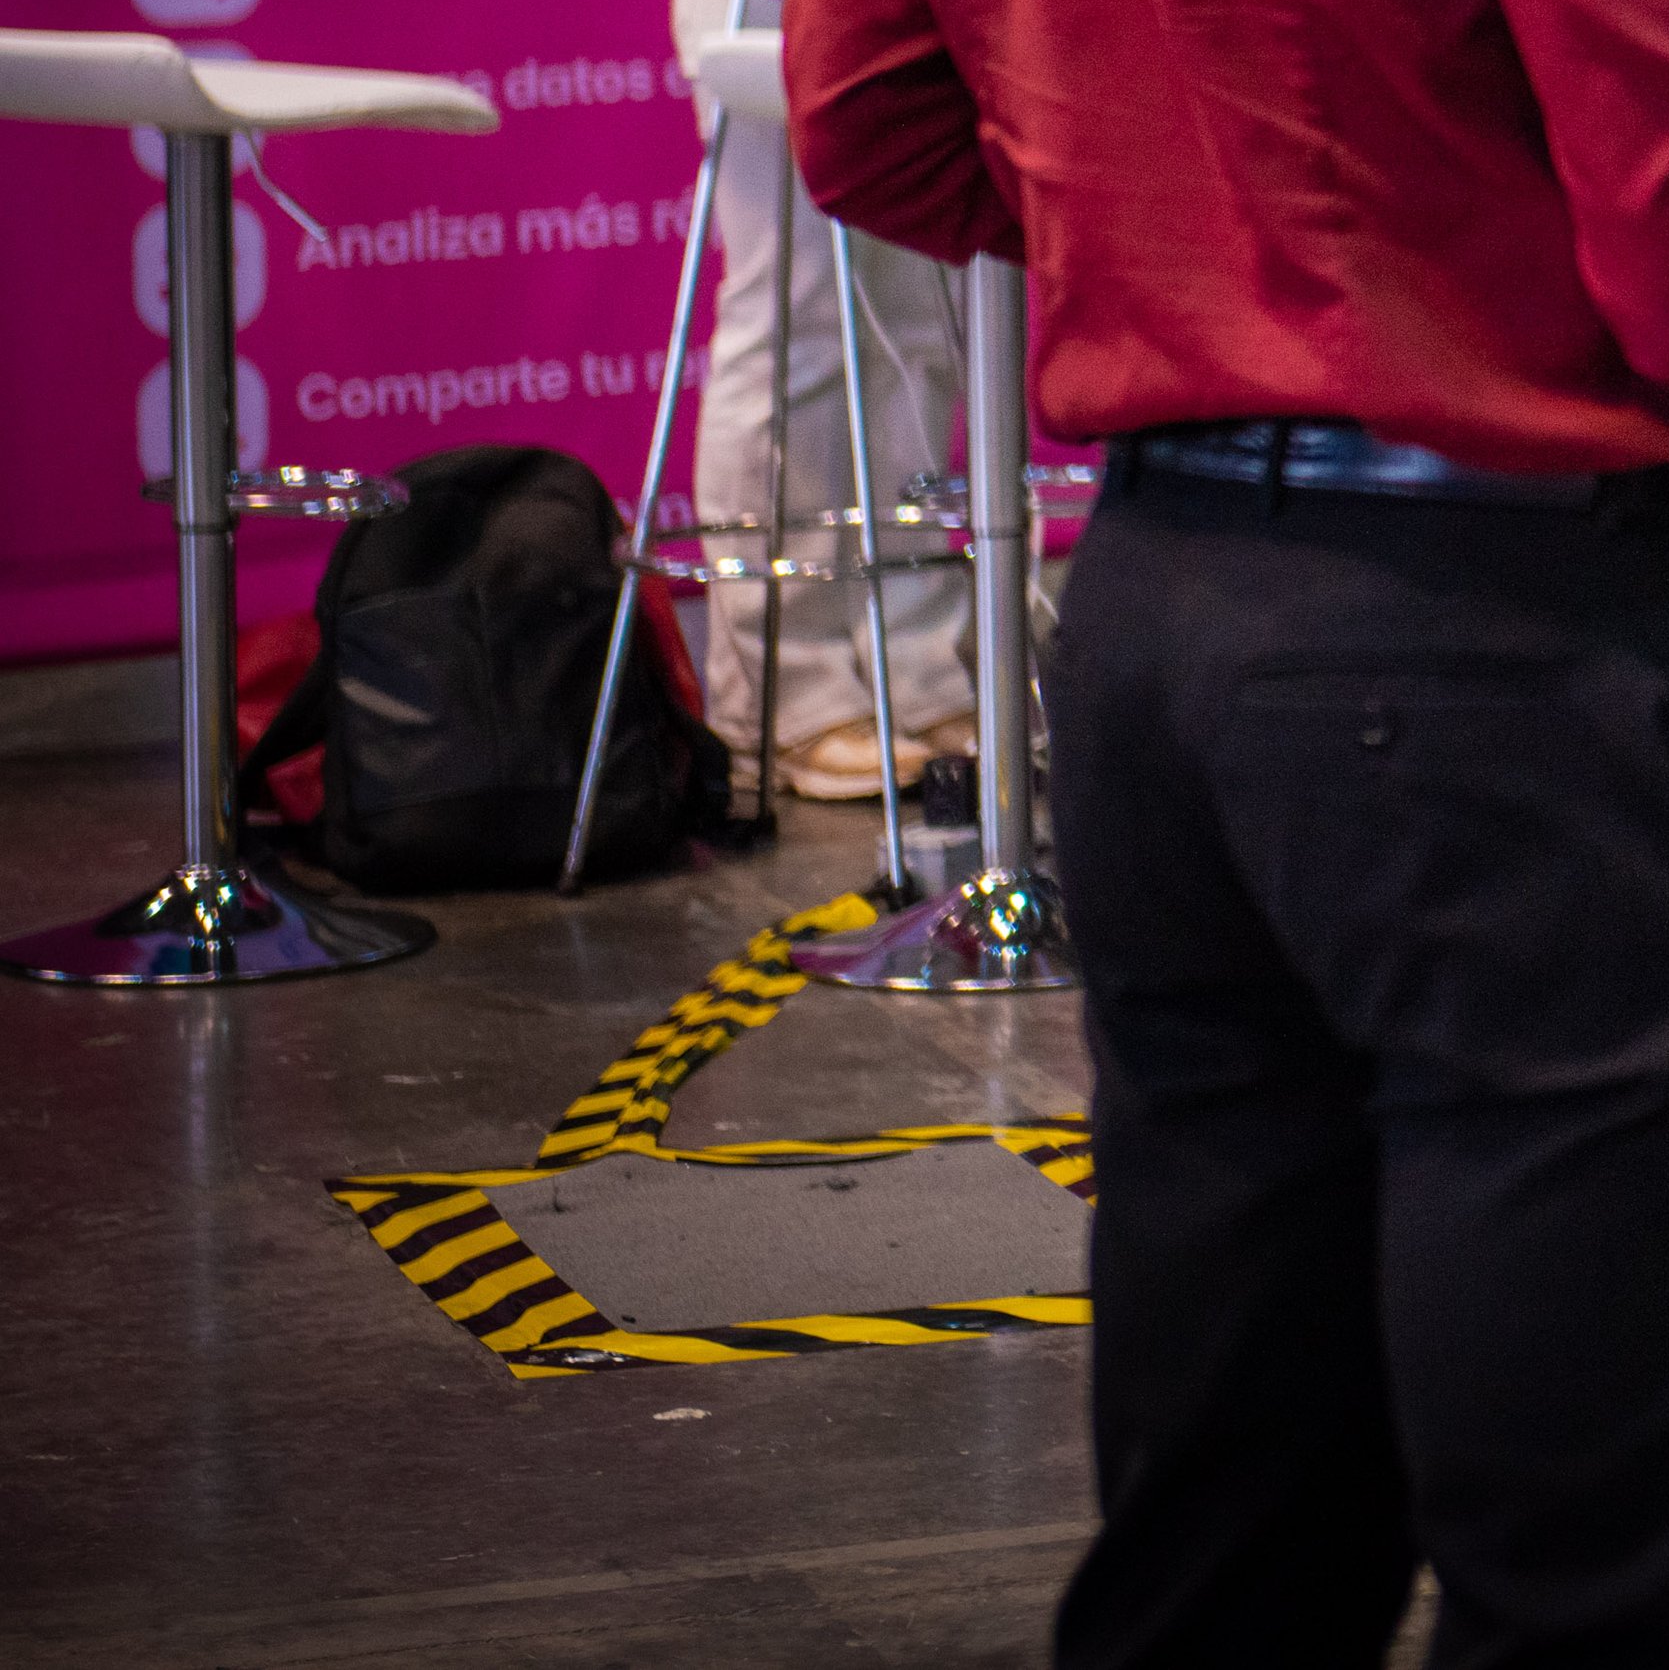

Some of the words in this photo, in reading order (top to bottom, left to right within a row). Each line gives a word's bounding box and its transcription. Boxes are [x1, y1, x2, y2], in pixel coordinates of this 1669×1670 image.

[503, 56, 653, 111] datos
[297, 205, 503, 272] Analiza
[516, 192, 640, 254] más
[297, 354, 571, 426] Comparte
[580, 350, 636, 397] tu
